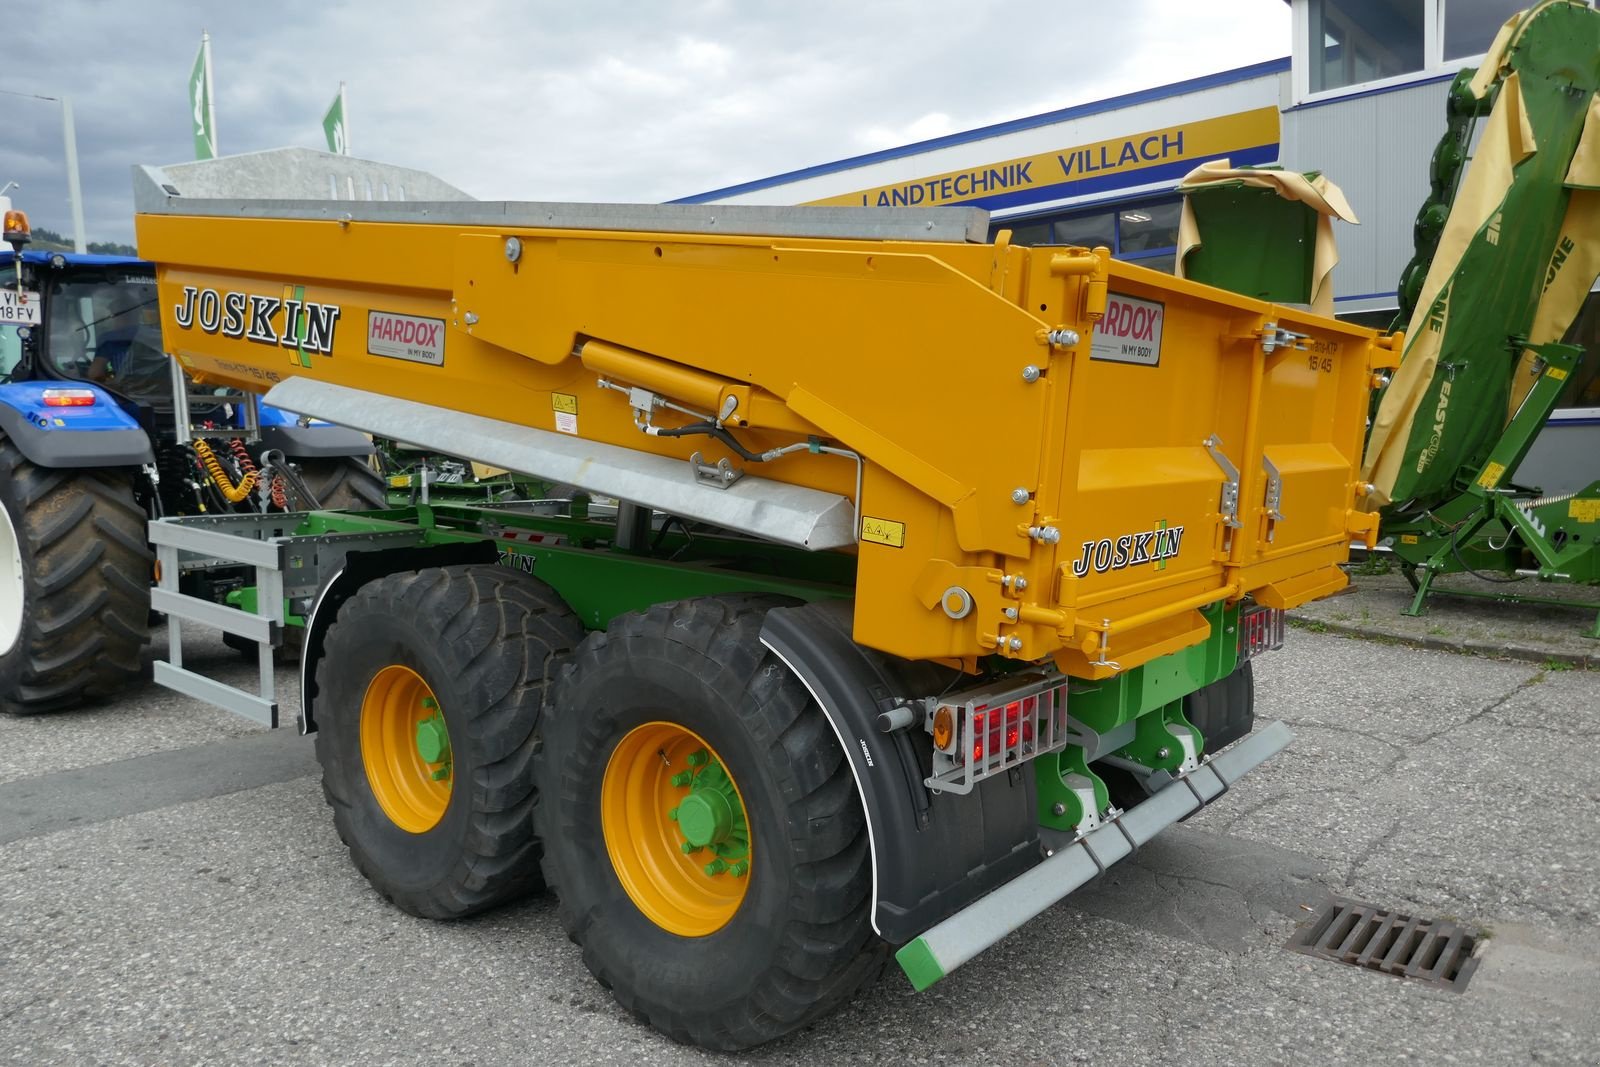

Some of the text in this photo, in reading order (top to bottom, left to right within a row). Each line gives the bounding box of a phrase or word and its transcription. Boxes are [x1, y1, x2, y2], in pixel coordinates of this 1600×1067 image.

[1058, 131, 1184, 176] VILLACH
[17, 307, 33, 320] FV
[175, 286, 340, 355] JOSKIN
[1092, 300, 1158, 341] ARDOX
[371, 316, 439, 348] HARDOX
[413, 349, 421, 357] MY
[421, 351, 436, 359] BODY
[1121, 344, 1128, 354] IN
[1128, 345, 1137, 356] MY
[1137, 346, 1152, 357] BODY
[1308, 355, 1333, 373] 15/45
[496, 550, 536, 574] KIN
[1073, 526, 1184, 577] JOSKIN
[859, 739, 874, 767] JOSKIN
